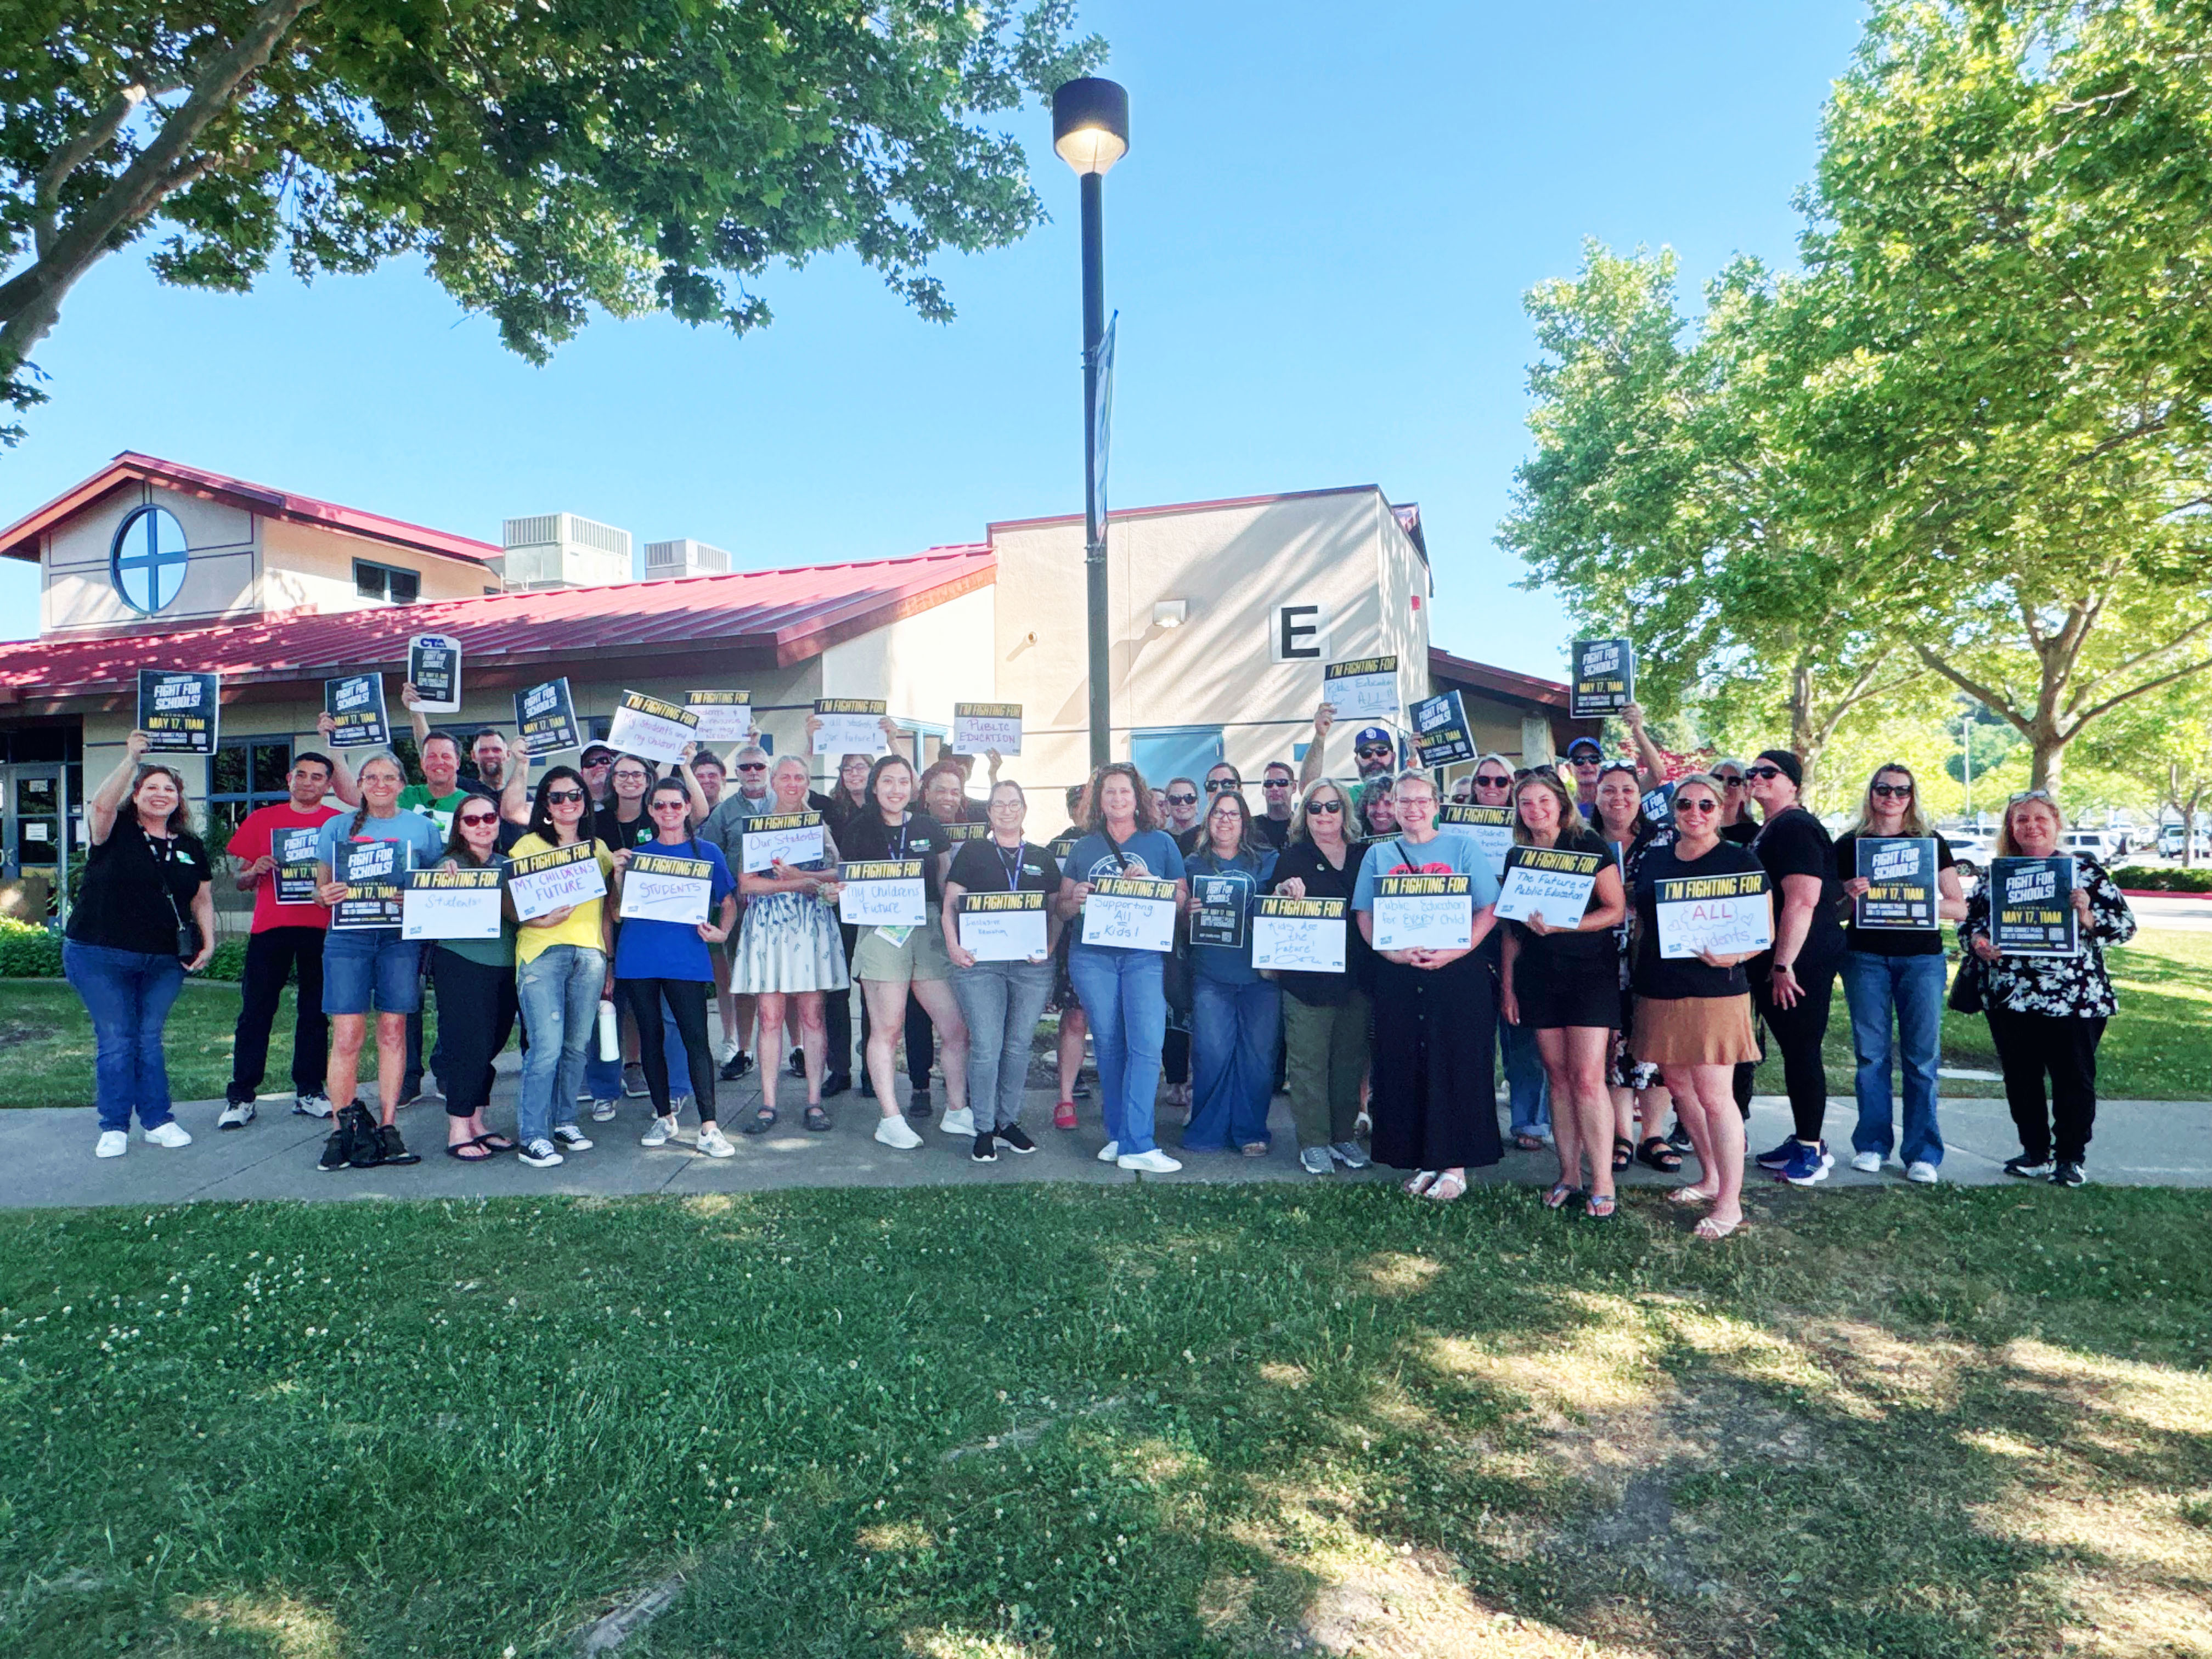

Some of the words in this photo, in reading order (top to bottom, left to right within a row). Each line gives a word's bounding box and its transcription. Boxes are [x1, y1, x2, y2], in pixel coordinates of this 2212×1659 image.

[1281, 605, 1320, 659] E
[421, 638, 447, 648] CTA
[1583, 650, 1604, 665] FIGHT
[1605, 647, 1619, 659] FOR
[1330, 664, 1344, 678] I'M
[1344, 659, 1379, 675] FIGHTING
[1379, 657, 1396, 672] FOR
[1584, 658, 1619, 676] SCHOOLS!
[154, 684, 182, 697] FIGHT
[183, 682, 201, 695] FOR
[336, 686, 355, 701] FIGHT
[356, 681, 369, 694] FOR
[1579, 682, 1595, 693] MAY
[1607, 681, 1624, 692] 11AM
[155, 695, 201, 709] SCHOOLS!
[524, 692, 541, 709] FIGHT
[543, 686, 555, 701] FOR
[690, 693, 702, 704] I'M
[703, 693, 734, 704] FIGHTING
[735, 693, 749, 703] FOR
[626, 695, 644, 710] I'M
[641, 699, 681, 720] FIGHTING
[680, 711, 698, 727] FOR
[820, 701, 832, 712] I'M
[833, 700, 869, 713] FIGHTING
[870, 701, 885, 713] FOR
[960, 704, 972, 715] I'M
[973, 704, 1006, 716] FIGHTING
[1006, 706, 1020, 716] FOR
[1419, 706, 1435, 722] FIGHT
[1436, 699, 1449, 713] FOR
[149, 717, 169, 729] MAY
[171, 718, 182, 730] 17,
[185, 719, 205, 730] 11AM
[334, 715, 348, 726] MAY
[360, 713, 376, 723] 11AM
[524, 722, 538, 733] MAY
[549, 716, 566, 728] 11AM
[960, 732, 1015, 743] EDUCATION
[1444, 730, 1462, 742] 11AM
[749, 818, 763, 831] I'M
[764, 815, 802, 830] FIGHTING
[804, 813, 820, 826] FOR
[1446, 807, 1462, 821] I'M
[1463, 808, 1505, 824] FIGHTING
[751, 836, 771, 850] Our
[775, 831, 821, 844] Students
[968, 825, 984, 839] FOR
[284, 837, 307, 851] FIGHT
[309, 834, 319, 845] FO
[348, 851, 375, 867] FIGHT
[376, 848, 393, 862] FOR
[514, 859, 528, 876] I'M
[531, 849, 571, 872] FIGHTING
[573, 844, 590, 860] FOR
[1519, 850, 1537, 866] I'M
[1535, 851, 1578, 871] FIGHTING
[1576, 856, 1599, 873] FOR
[1872, 851, 1900, 867] FIGHT
[1901, 848, 1920, 862] FOR
[282, 868, 298, 878] MAY
[300, 867, 309, 878] 17,
[349, 861, 393, 880] SCHOOLS!
[634, 856, 651, 871] I'M
[650, 858, 692, 875] FIGHTING
[692, 864, 711, 878] FOR
[845, 865, 861, 879] I'M
[862, 863, 902, 878] FIGHTING
[904, 862, 921, 876] FOR
[1874, 861, 1920, 880] SCHOOLS!
[413, 872, 431, 887] I'M
[432, 872, 478, 887] FIGHTING
[478, 872, 499, 887] FOR
[515, 877, 533, 894] MY
[539, 862, 595, 885] CHILDRENS
[1381, 878, 1398, 895] I'M
[1400, 877, 1446, 894] FIGHTING
[1447, 877, 1468, 893] FOR
[1518, 872, 1534, 882] The
[1538, 874, 1576, 888] Future
[1579, 880, 1592, 889] of
[2006, 874, 2034, 890] FIGHT
[2036, 871, 2055, 885] FOR
[364, 887, 375, 899] 17,
[536, 877, 586, 901] FUTURE
[640, 882, 702, 898] STUDENTS
[1096, 878, 1112, 893] I'M
[1112, 879, 1155, 897] FIGHTING
[1155, 883, 1175, 899] FOR
[1515, 884, 1543, 895] Public
[1665, 882, 1683, 900] I'M
[1686, 878, 1737, 899] FIGHTING
[1740, 875, 1762, 894] FOR
[1867, 888, 1887, 899] MAY
[1889, 888, 1901, 901] 17,
[1903, 888, 1924, 900] 11AM
[2008, 885, 2055, 904] SCHOOLS!
[863, 902, 901, 914] Future
[966, 896, 981, 910] I'M
[983, 894, 1023, 910] FIGHTING
[1025, 894, 1043, 909] FOR
[1094, 898, 1153, 917] Supporting
[1261, 899, 1278, 915] I'M
[1279, 900, 1322, 916] FIGHTING
[1323, 901, 1343, 917] FOR
[1378, 899, 1410, 910] Public
[1420, 899, 1465, 912] Education
[1114, 910, 1131, 921] All
[1692, 904, 1732, 921] ALL
[2002, 911, 2022, 923] MAY
[2025, 911, 2037, 925] 17,
[2040, 911, 2062, 924] 11AM
